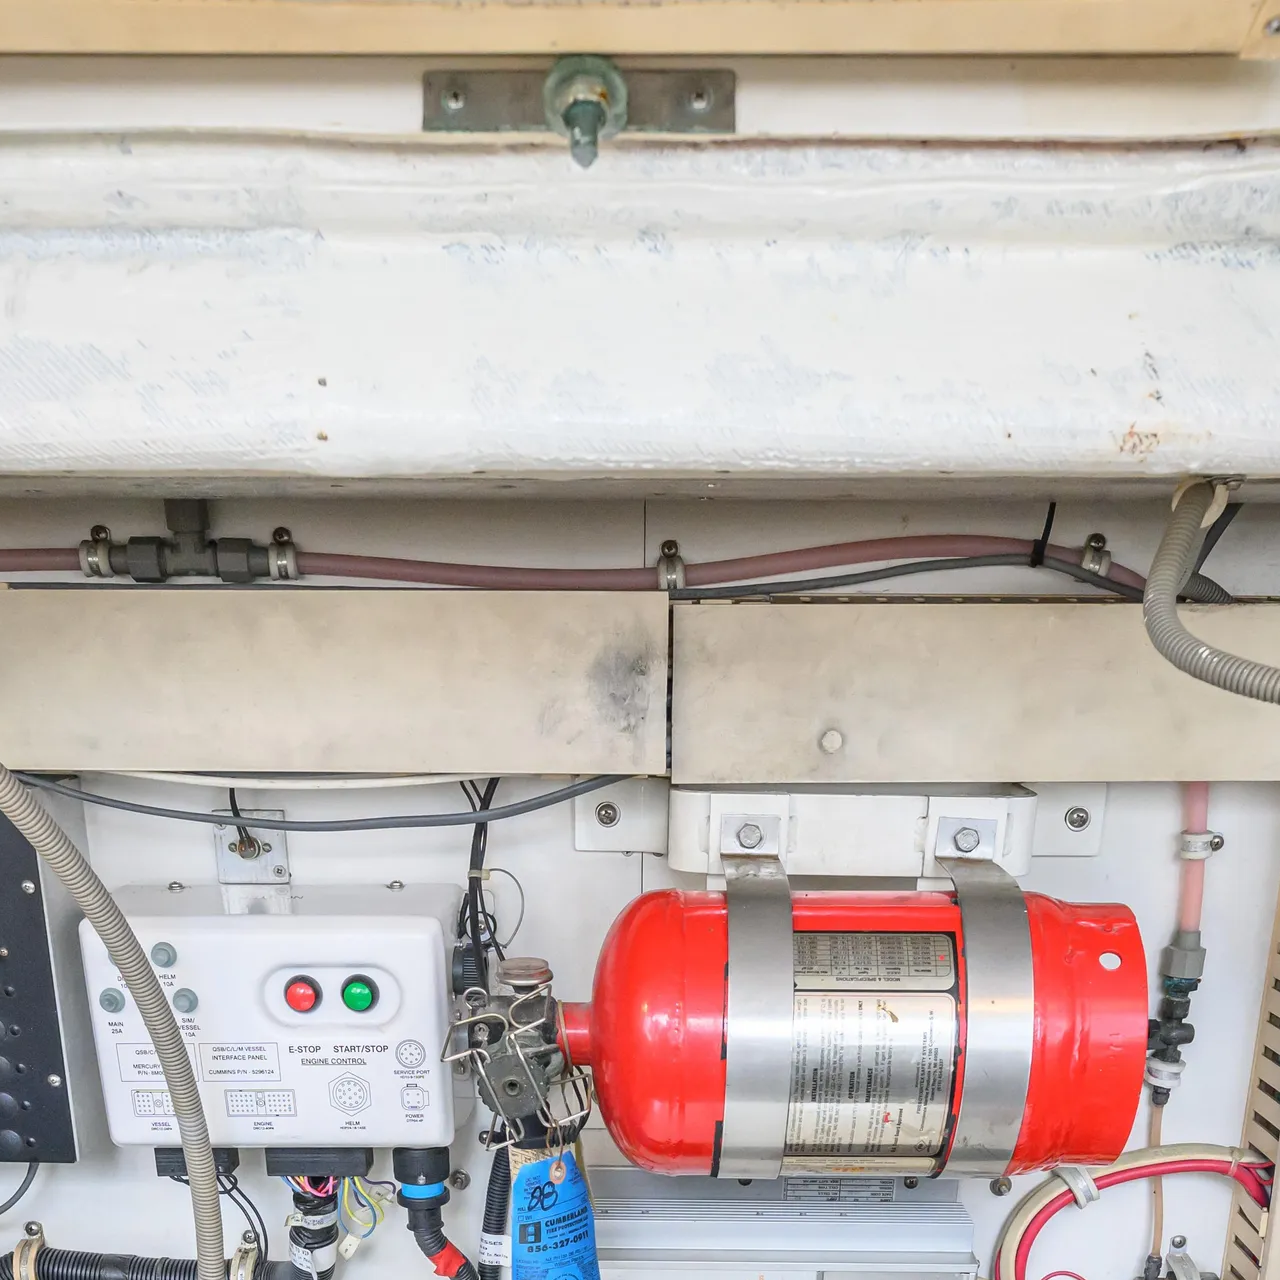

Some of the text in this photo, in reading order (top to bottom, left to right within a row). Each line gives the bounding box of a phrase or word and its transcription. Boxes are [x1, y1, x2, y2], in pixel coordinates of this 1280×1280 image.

[288, 1045, 389, 1054] E-STOP START/STOP
[865, 1068, 873, 1102] MAINTENANCE
[545, 1206, 588, 1227] CUMBERLAND
[527, 1230, 589, 1253] 856-327-0911
